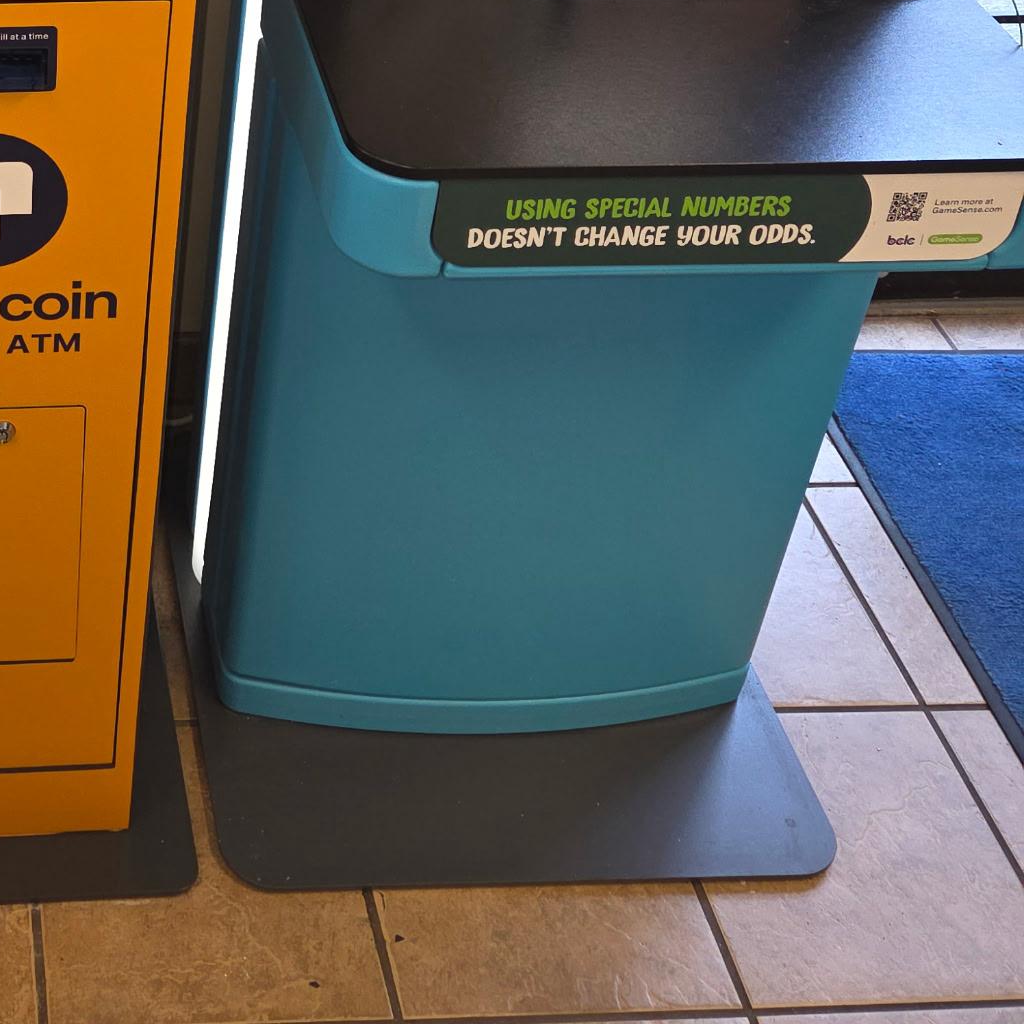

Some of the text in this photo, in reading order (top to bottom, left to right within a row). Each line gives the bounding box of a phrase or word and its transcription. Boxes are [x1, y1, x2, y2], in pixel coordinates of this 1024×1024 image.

[10, 32, 20, 41] at
[28, 31, 49, 41] time
[506, 195, 792, 221] USING SPECIAL NUMBERS
[932, 206, 1003, 215] GameSense.com
[467, 223, 816, 249] DOESN'T CHANGE YOUR ODDS.
[887, 235, 916, 246] bclc
[6, 332, 82, 354] ATM
